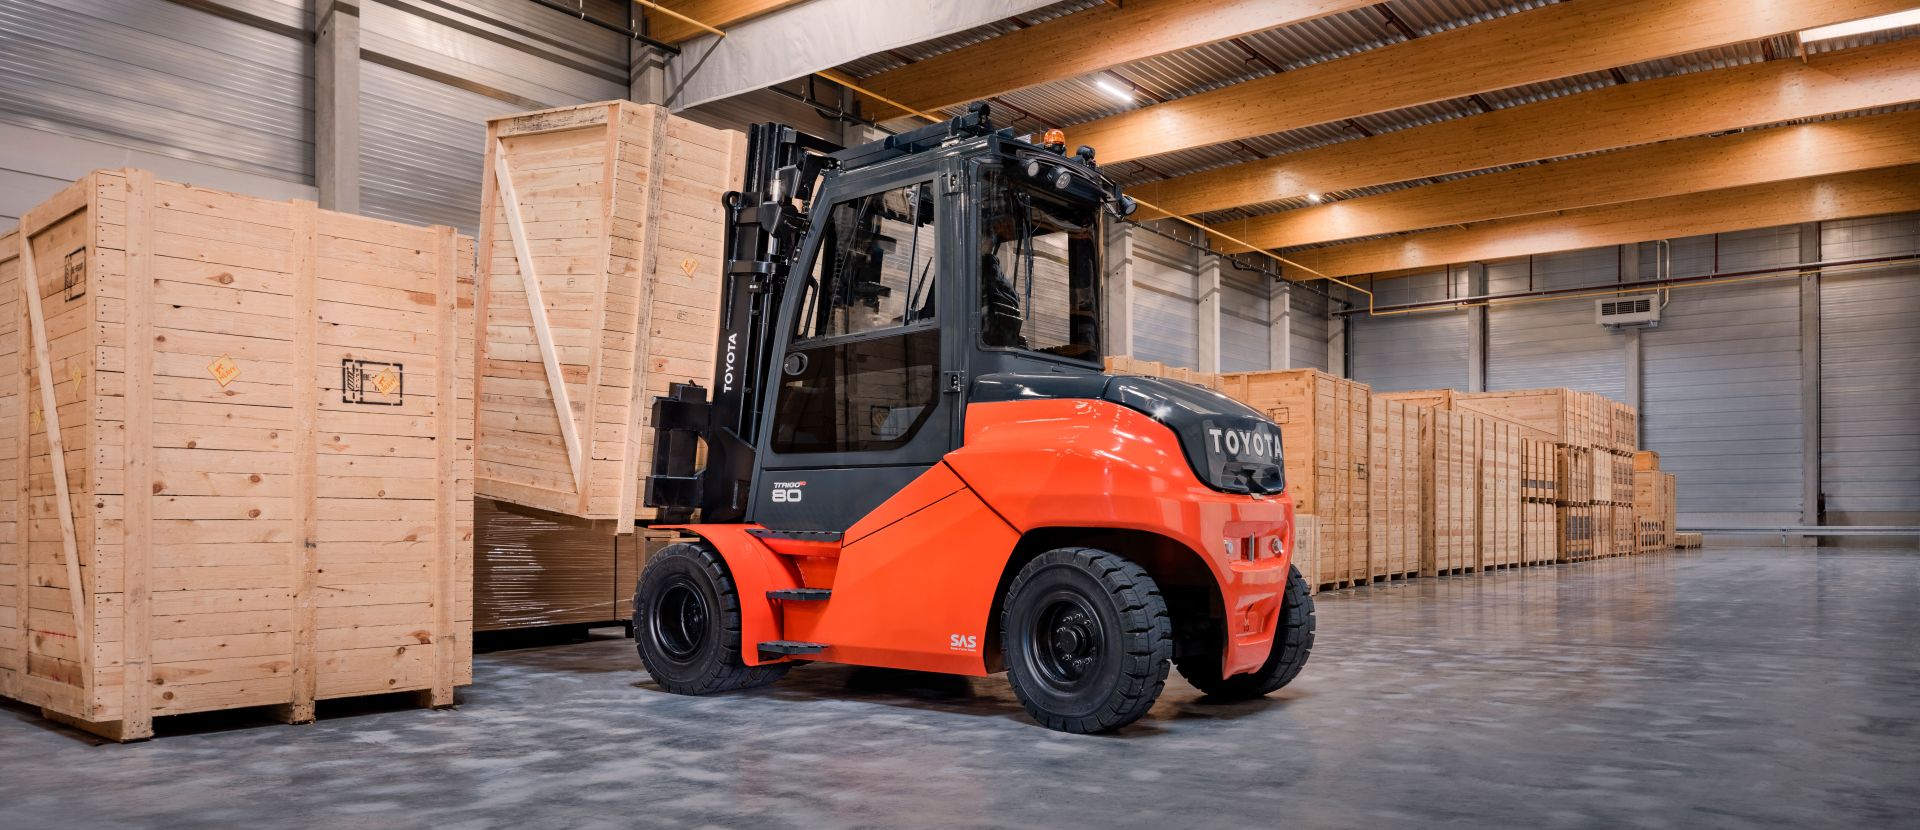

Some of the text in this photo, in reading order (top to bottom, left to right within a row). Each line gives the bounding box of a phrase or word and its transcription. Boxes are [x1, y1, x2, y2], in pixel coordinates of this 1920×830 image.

[723, 332, 738, 393] TOYOTA
[1208, 428, 1283, 460] TOYOTA
[772, 489, 802, 502] 80
[950, 633, 977, 649] SAS
